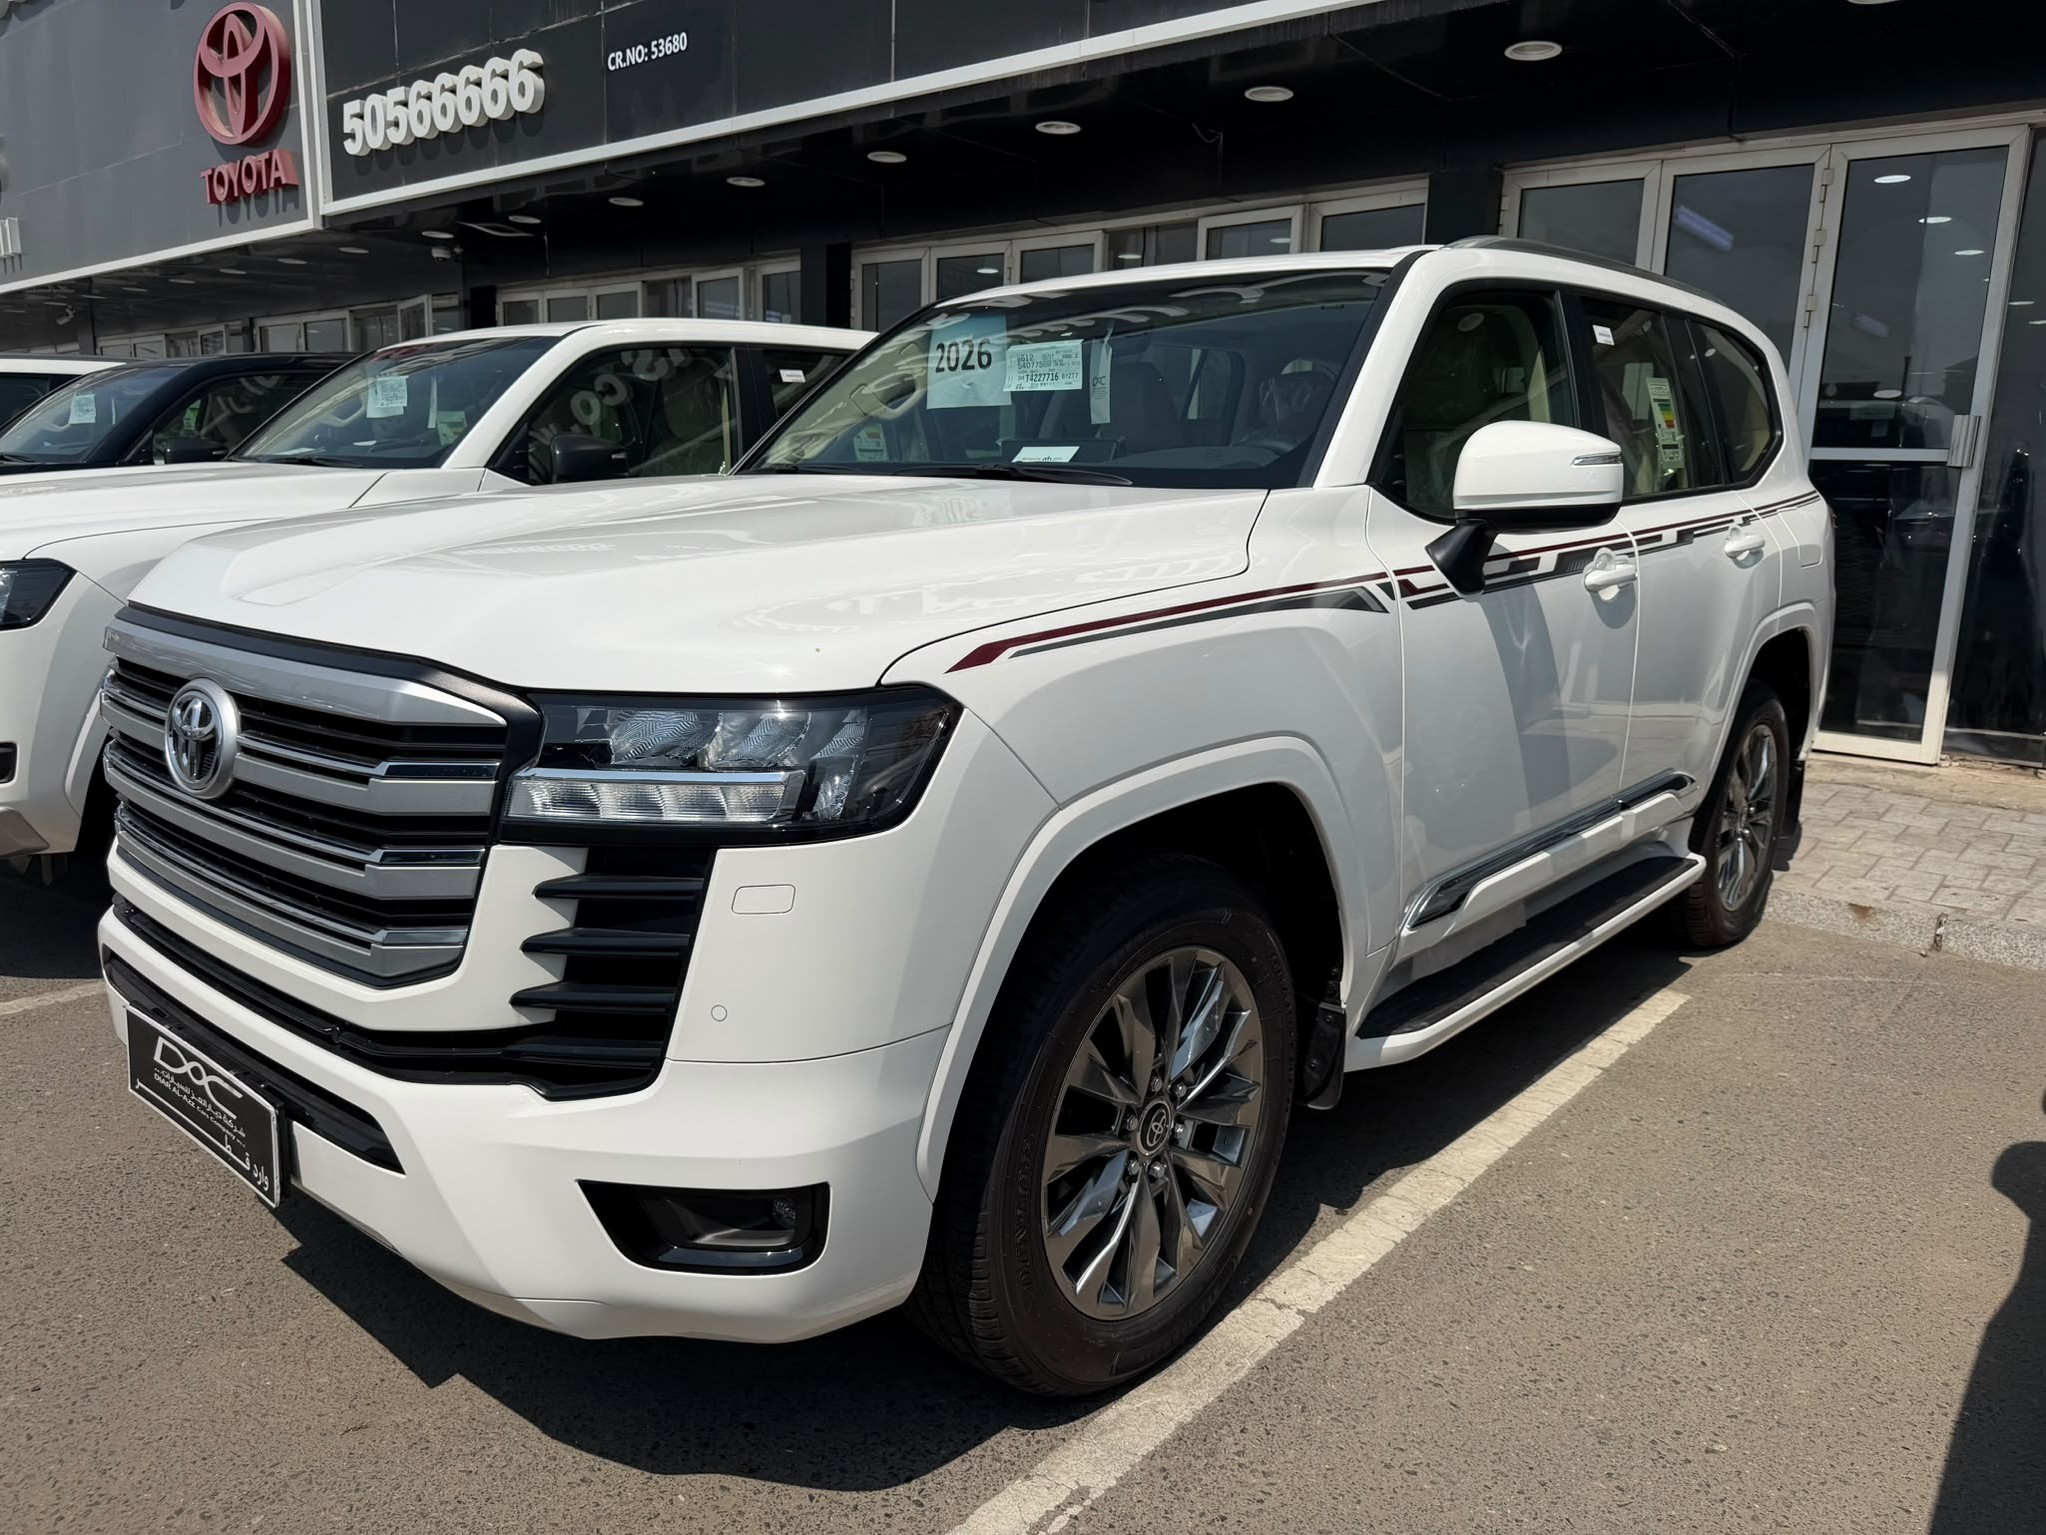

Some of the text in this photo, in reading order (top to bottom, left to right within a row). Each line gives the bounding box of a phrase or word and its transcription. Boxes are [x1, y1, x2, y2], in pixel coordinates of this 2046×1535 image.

[607, 31, 688, 71] CR.NO: 53680
[343, 49, 546, 157] 50566666
[200, 149, 300, 206] TOYOTA
[935, 339, 993, 373] 2026
[253, 1163, 270, 1191] وارد
